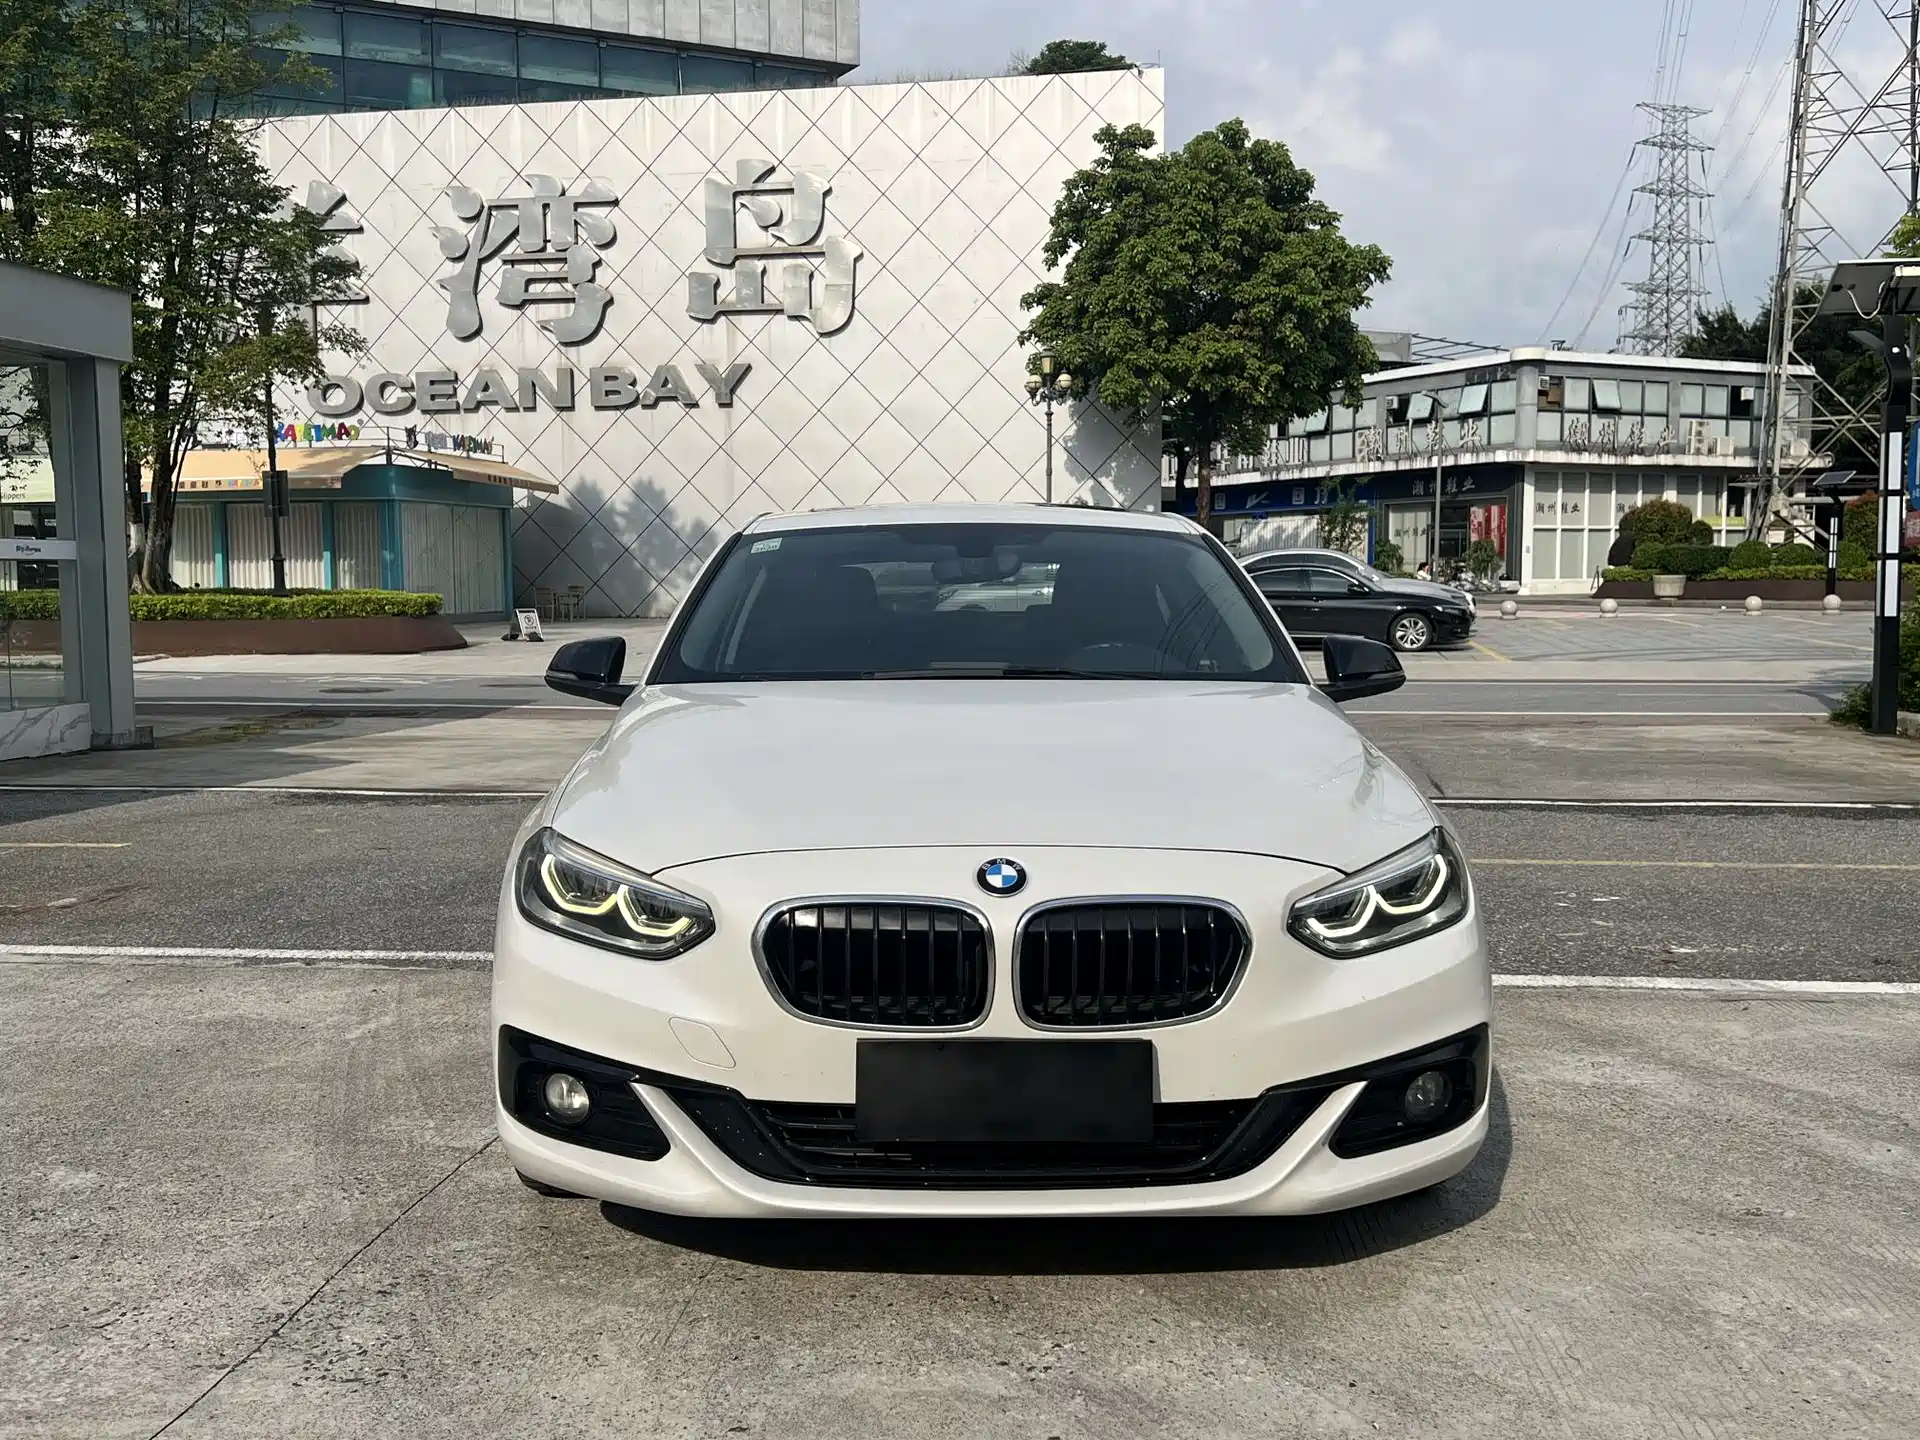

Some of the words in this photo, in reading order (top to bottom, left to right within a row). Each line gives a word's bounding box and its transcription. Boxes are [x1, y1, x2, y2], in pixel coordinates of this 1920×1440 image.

[307, 367, 576, 418] OCEAN
[590, 363, 752, 411] BAY
[982, 859, 1022, 870] BMW
